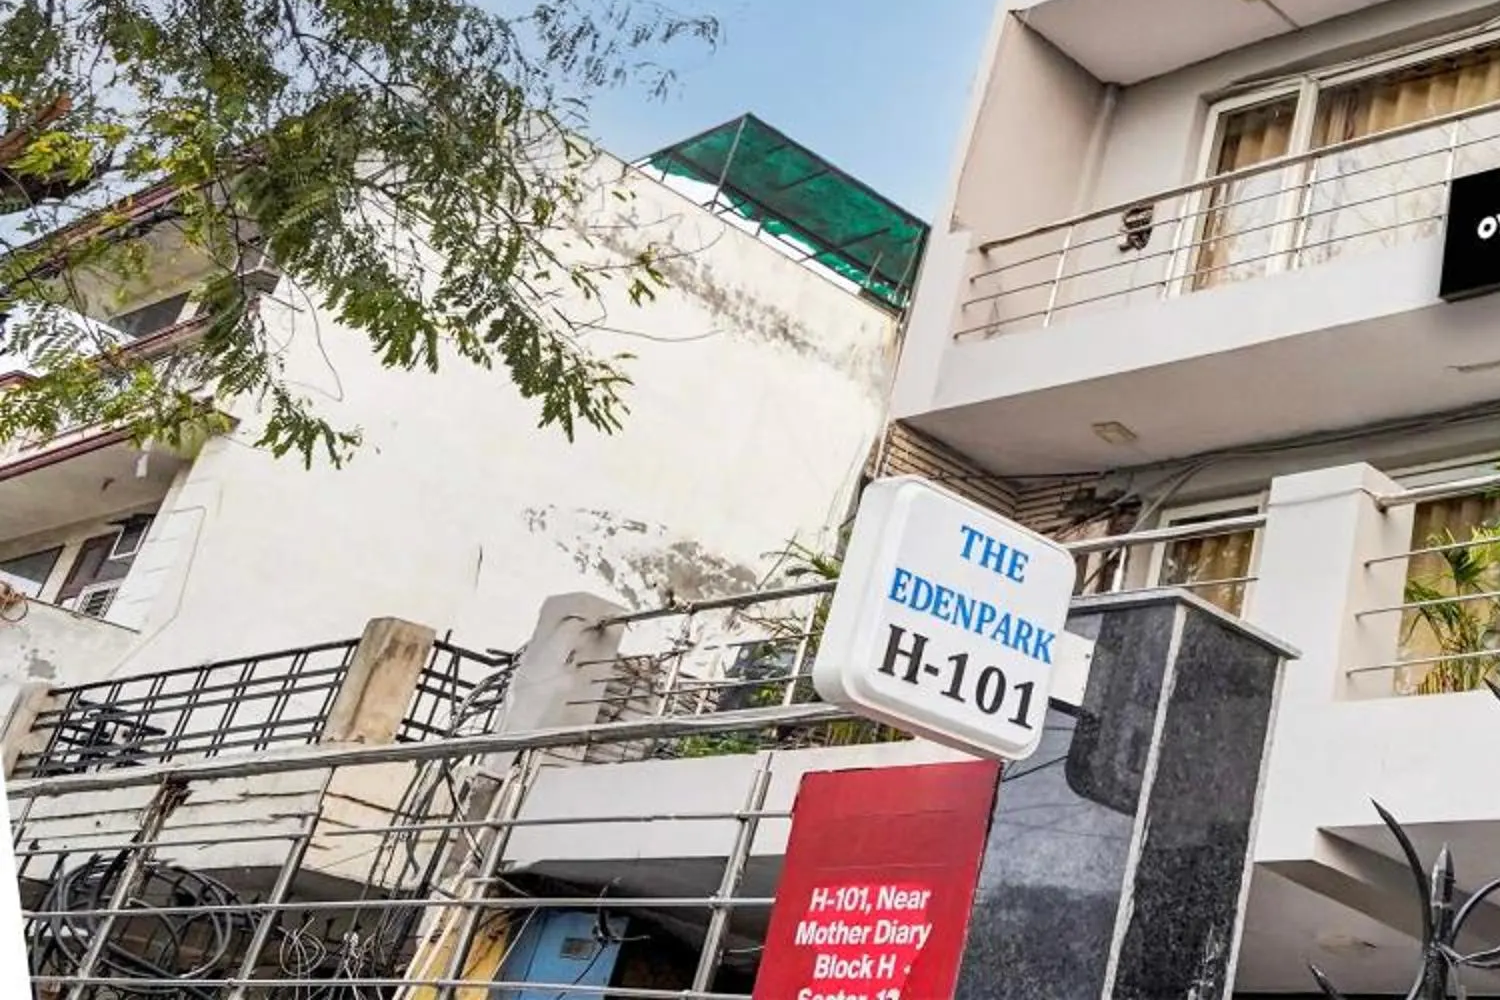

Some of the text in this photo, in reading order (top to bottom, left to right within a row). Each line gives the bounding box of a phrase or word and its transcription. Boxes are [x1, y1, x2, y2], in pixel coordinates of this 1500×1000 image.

[959, 524, 1029, 583] THE
[888, 567, 1056, 664] EDENPARK
[878, 623, 1035, 730] H-101
[809, 885, 931, 915] H-101, Near
[794, 919, 932, 950] Mother Diary
[813, 953, 896, 979] Block H
